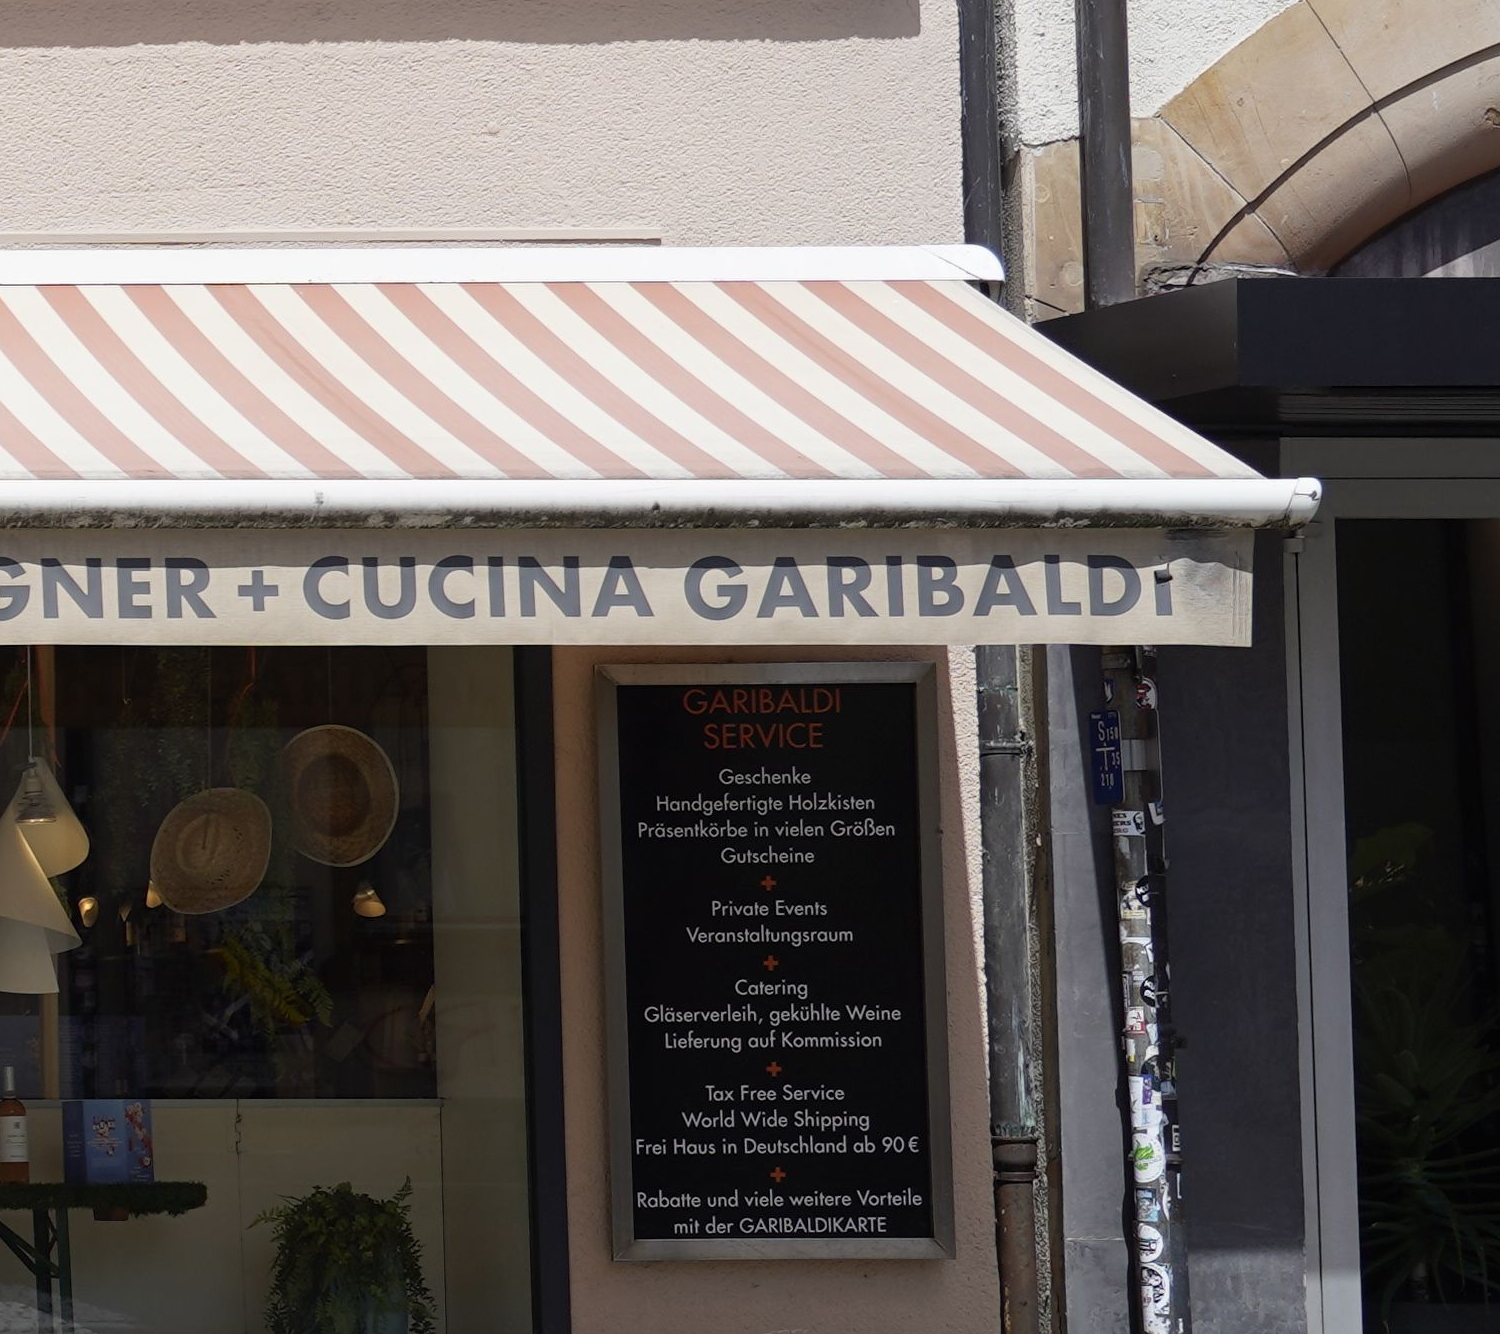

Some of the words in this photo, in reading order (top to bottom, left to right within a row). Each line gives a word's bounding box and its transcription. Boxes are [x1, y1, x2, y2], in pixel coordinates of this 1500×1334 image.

[305, 556, 656, 618] CUCINA
[682, 688, 841, 716] GARIBALDI
[703, 722, 824, 750] SERVICE
[718, 765, 812, 785] Geschenke
[656, 792, 783, 817] Handgefertigte
[788, 791, 875, 811] Holzkisten
[638, 819, 748, 838] Präsentkörbe
[753, 821, 769, 837] in
[774, 818, 824, 837] vielen
[830, 817, 896, 837] Größen
[720, 845, 815, 864] Gutscheine
[711, 900, 770, 917] Private
[775, 899, 828, 916] Events
[685, 924, 854, 948] Veranstaltungsraum
[734, 978, 809, 1000] Catering
[643, 1003, 763, 1025] Gläserverleih,
[769, 1002, 841, 1027] gekühlte
[845, 1004, 902, 1021] Weine
[664, 1029, 742, 1054] Lieferung
[747, 1029, 777, 1049] auf
[781, 1031, 882, 1048] Kommission
[705, 1084, 735, 1102] Tax
[740, 1084, 777, 1101] Free
[782, 1084, 845, 1101] Service
[681, 1109, 735, 1128] World
[740, 1108, 788, 1128] Wide
[794, 1108, 870, 1132] Shipping
[637, 1189, 702, 1208] Rabatte
[707, 1188, 739, 1208] und
[744, 1188, 784, 1208] viele
[788, 1190, 852, 1207] weitere
[856, 1187, 923, 1207] Vorteile
